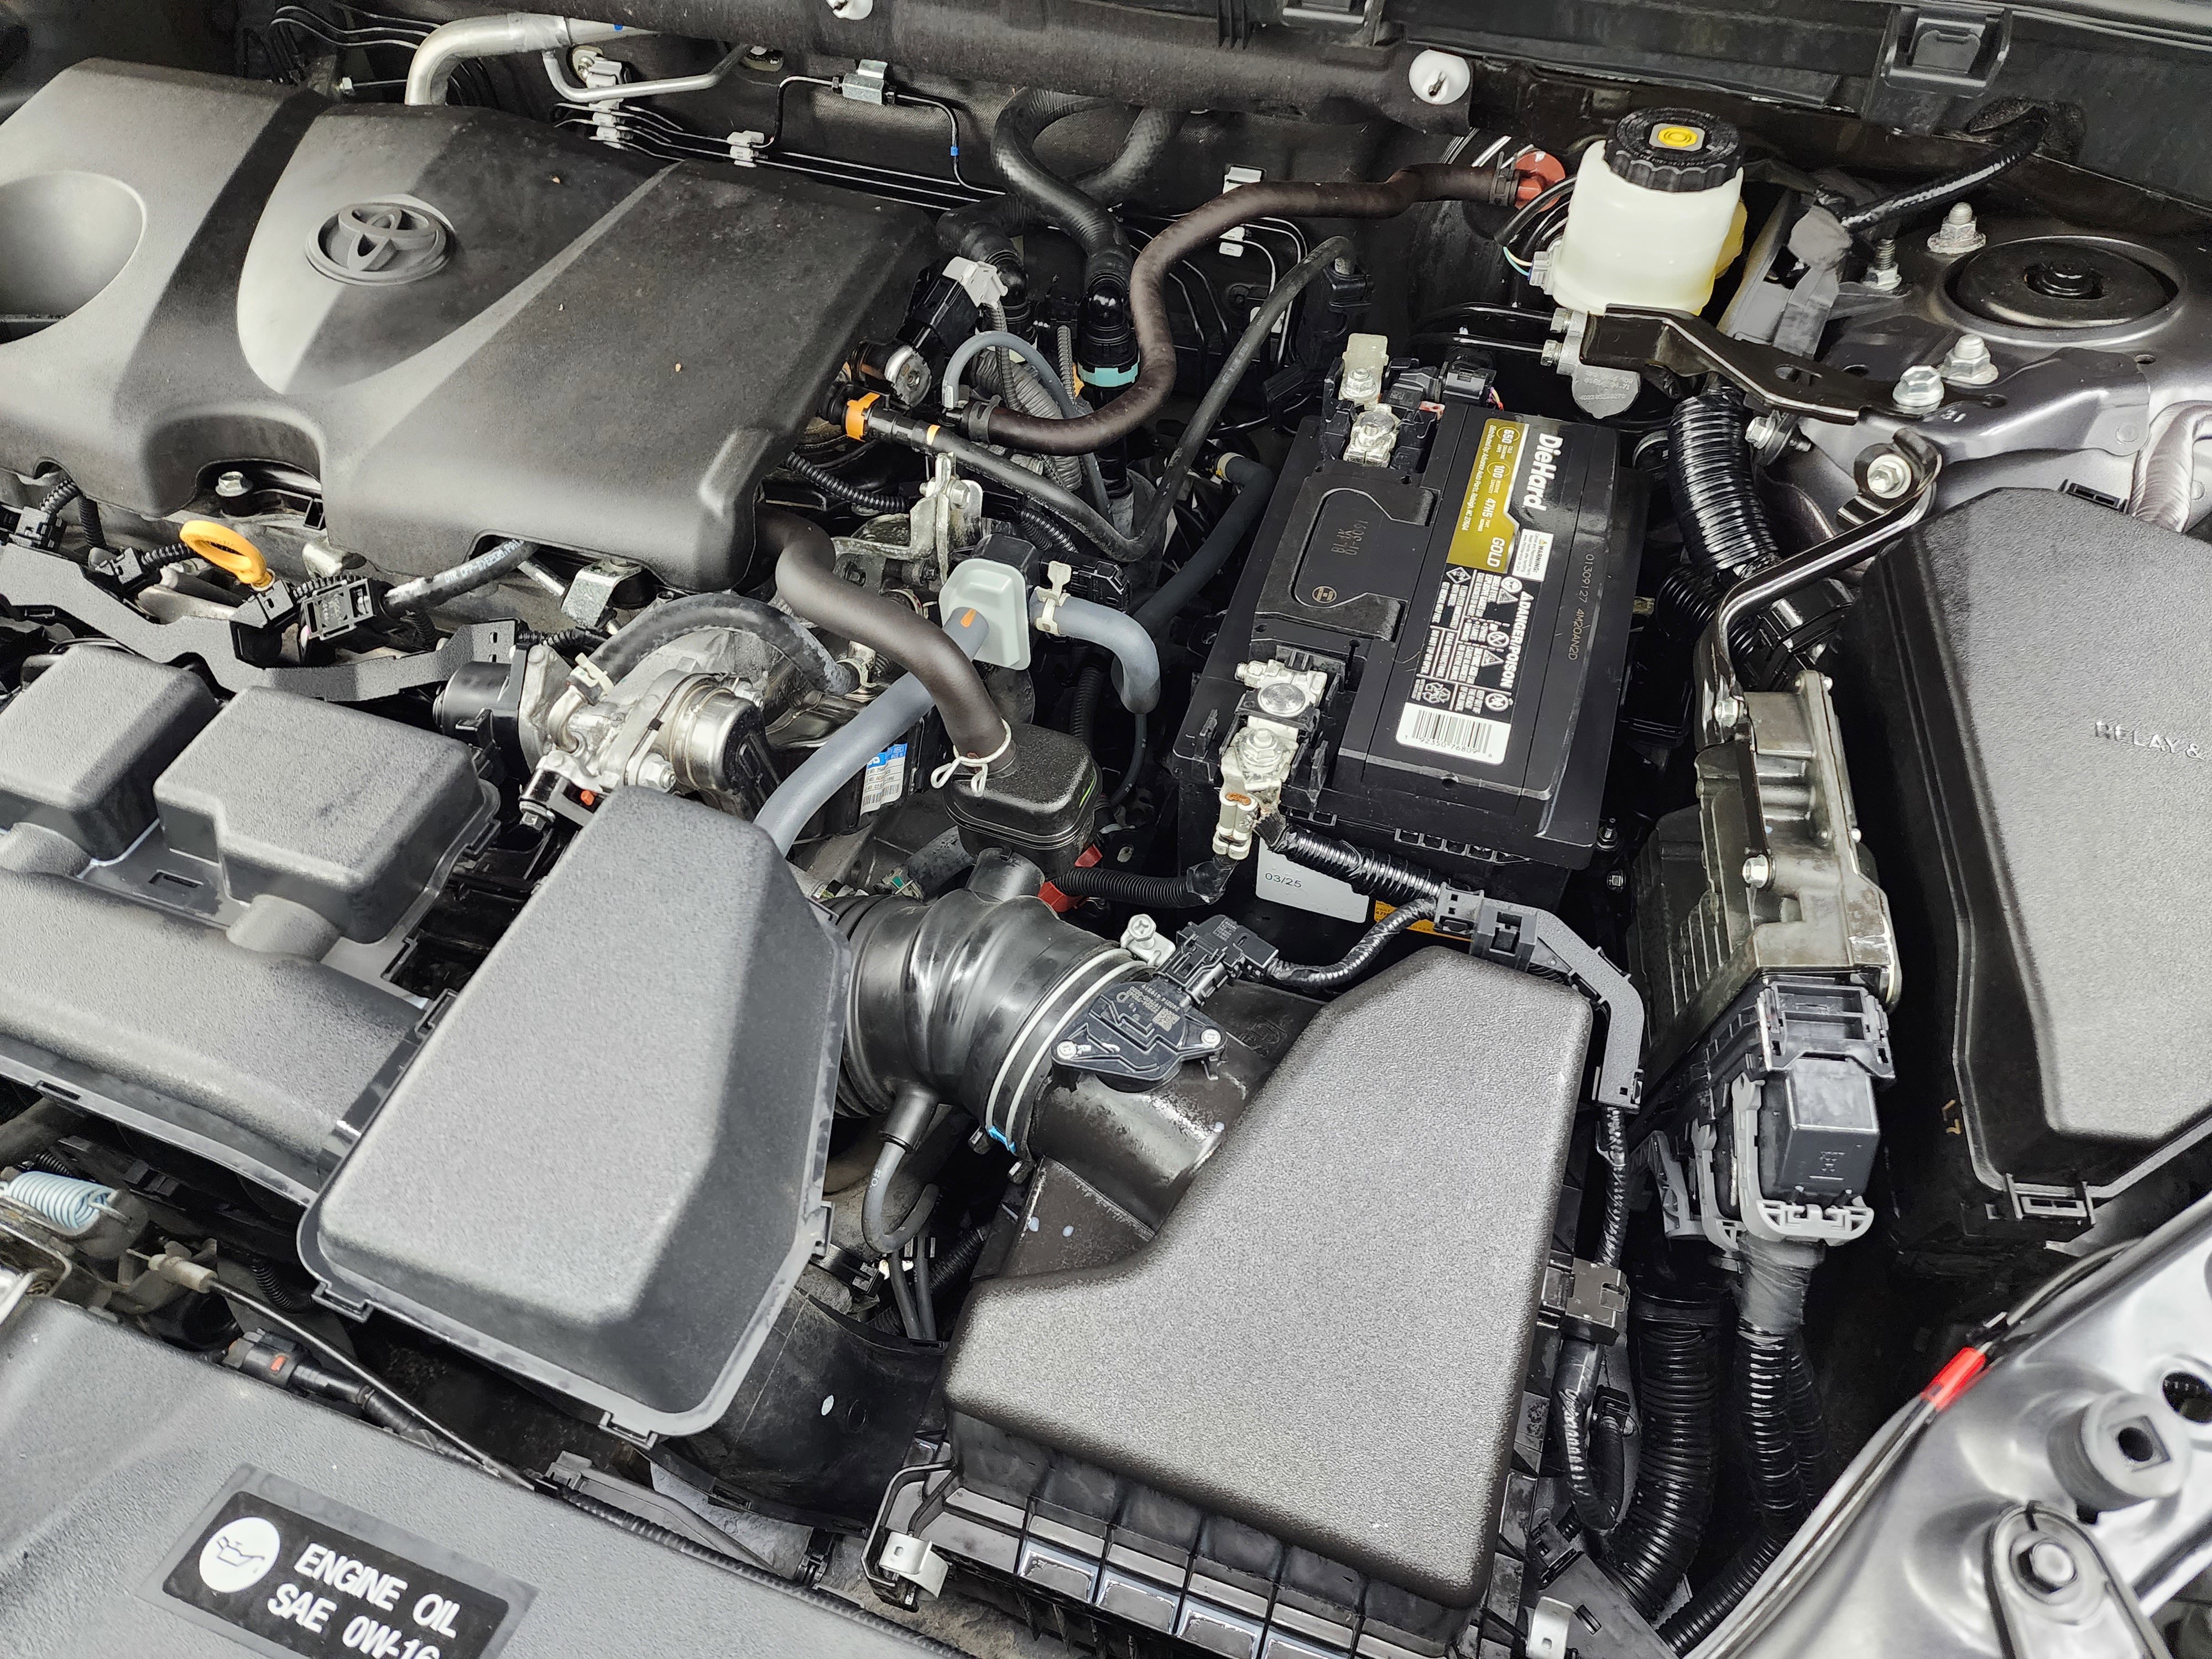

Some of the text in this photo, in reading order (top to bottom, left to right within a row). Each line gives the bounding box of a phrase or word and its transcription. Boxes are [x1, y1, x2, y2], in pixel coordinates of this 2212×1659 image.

[1501, 429, 1515, 444] 650
[1478, 452, 1489, 470] Advance
[1475, 469, 1484, 480] Auto
[1491, 465, 1505, 478] 100
[1522, 432, 1563, 511] DieHard
[1481, 498, 1497, 518] 47H5
[1485, 536, 1506, 567] GOLD
[1532, 545, 1544, 572] WARNING:
[1480, 573, 1493, 596] EXPLOSIVE
[1436, 588, 1448, 604] MEDICAL
[1455, 597, 1464, 606] EYES
[1477, 596, 1488, 609] GASES
[1434, 603, 1444, 613] HELP
[1567, 553, 1594, 661] 01309127 4M20AN2D
[1428, 637, 1437, 646] NOT
[1444, 632, 1455, 645] READ
[1498, 601, 1532, 689] DANGER/POISON
[1426, 646, 1434, 654] TIP
[1453, 650, 1464, 666] SEVERE
[1463, 646, 1474, 660] CAUSE
[2092, 718, 2207, 761] RELAY &
[1450, 743, 1478, 754] 76809
[1264, 870, 1302, 888] 03/25
[294, 1542, 463, 1639] ENGINE OIL
[268, 1583, 337, 1633] SAE
